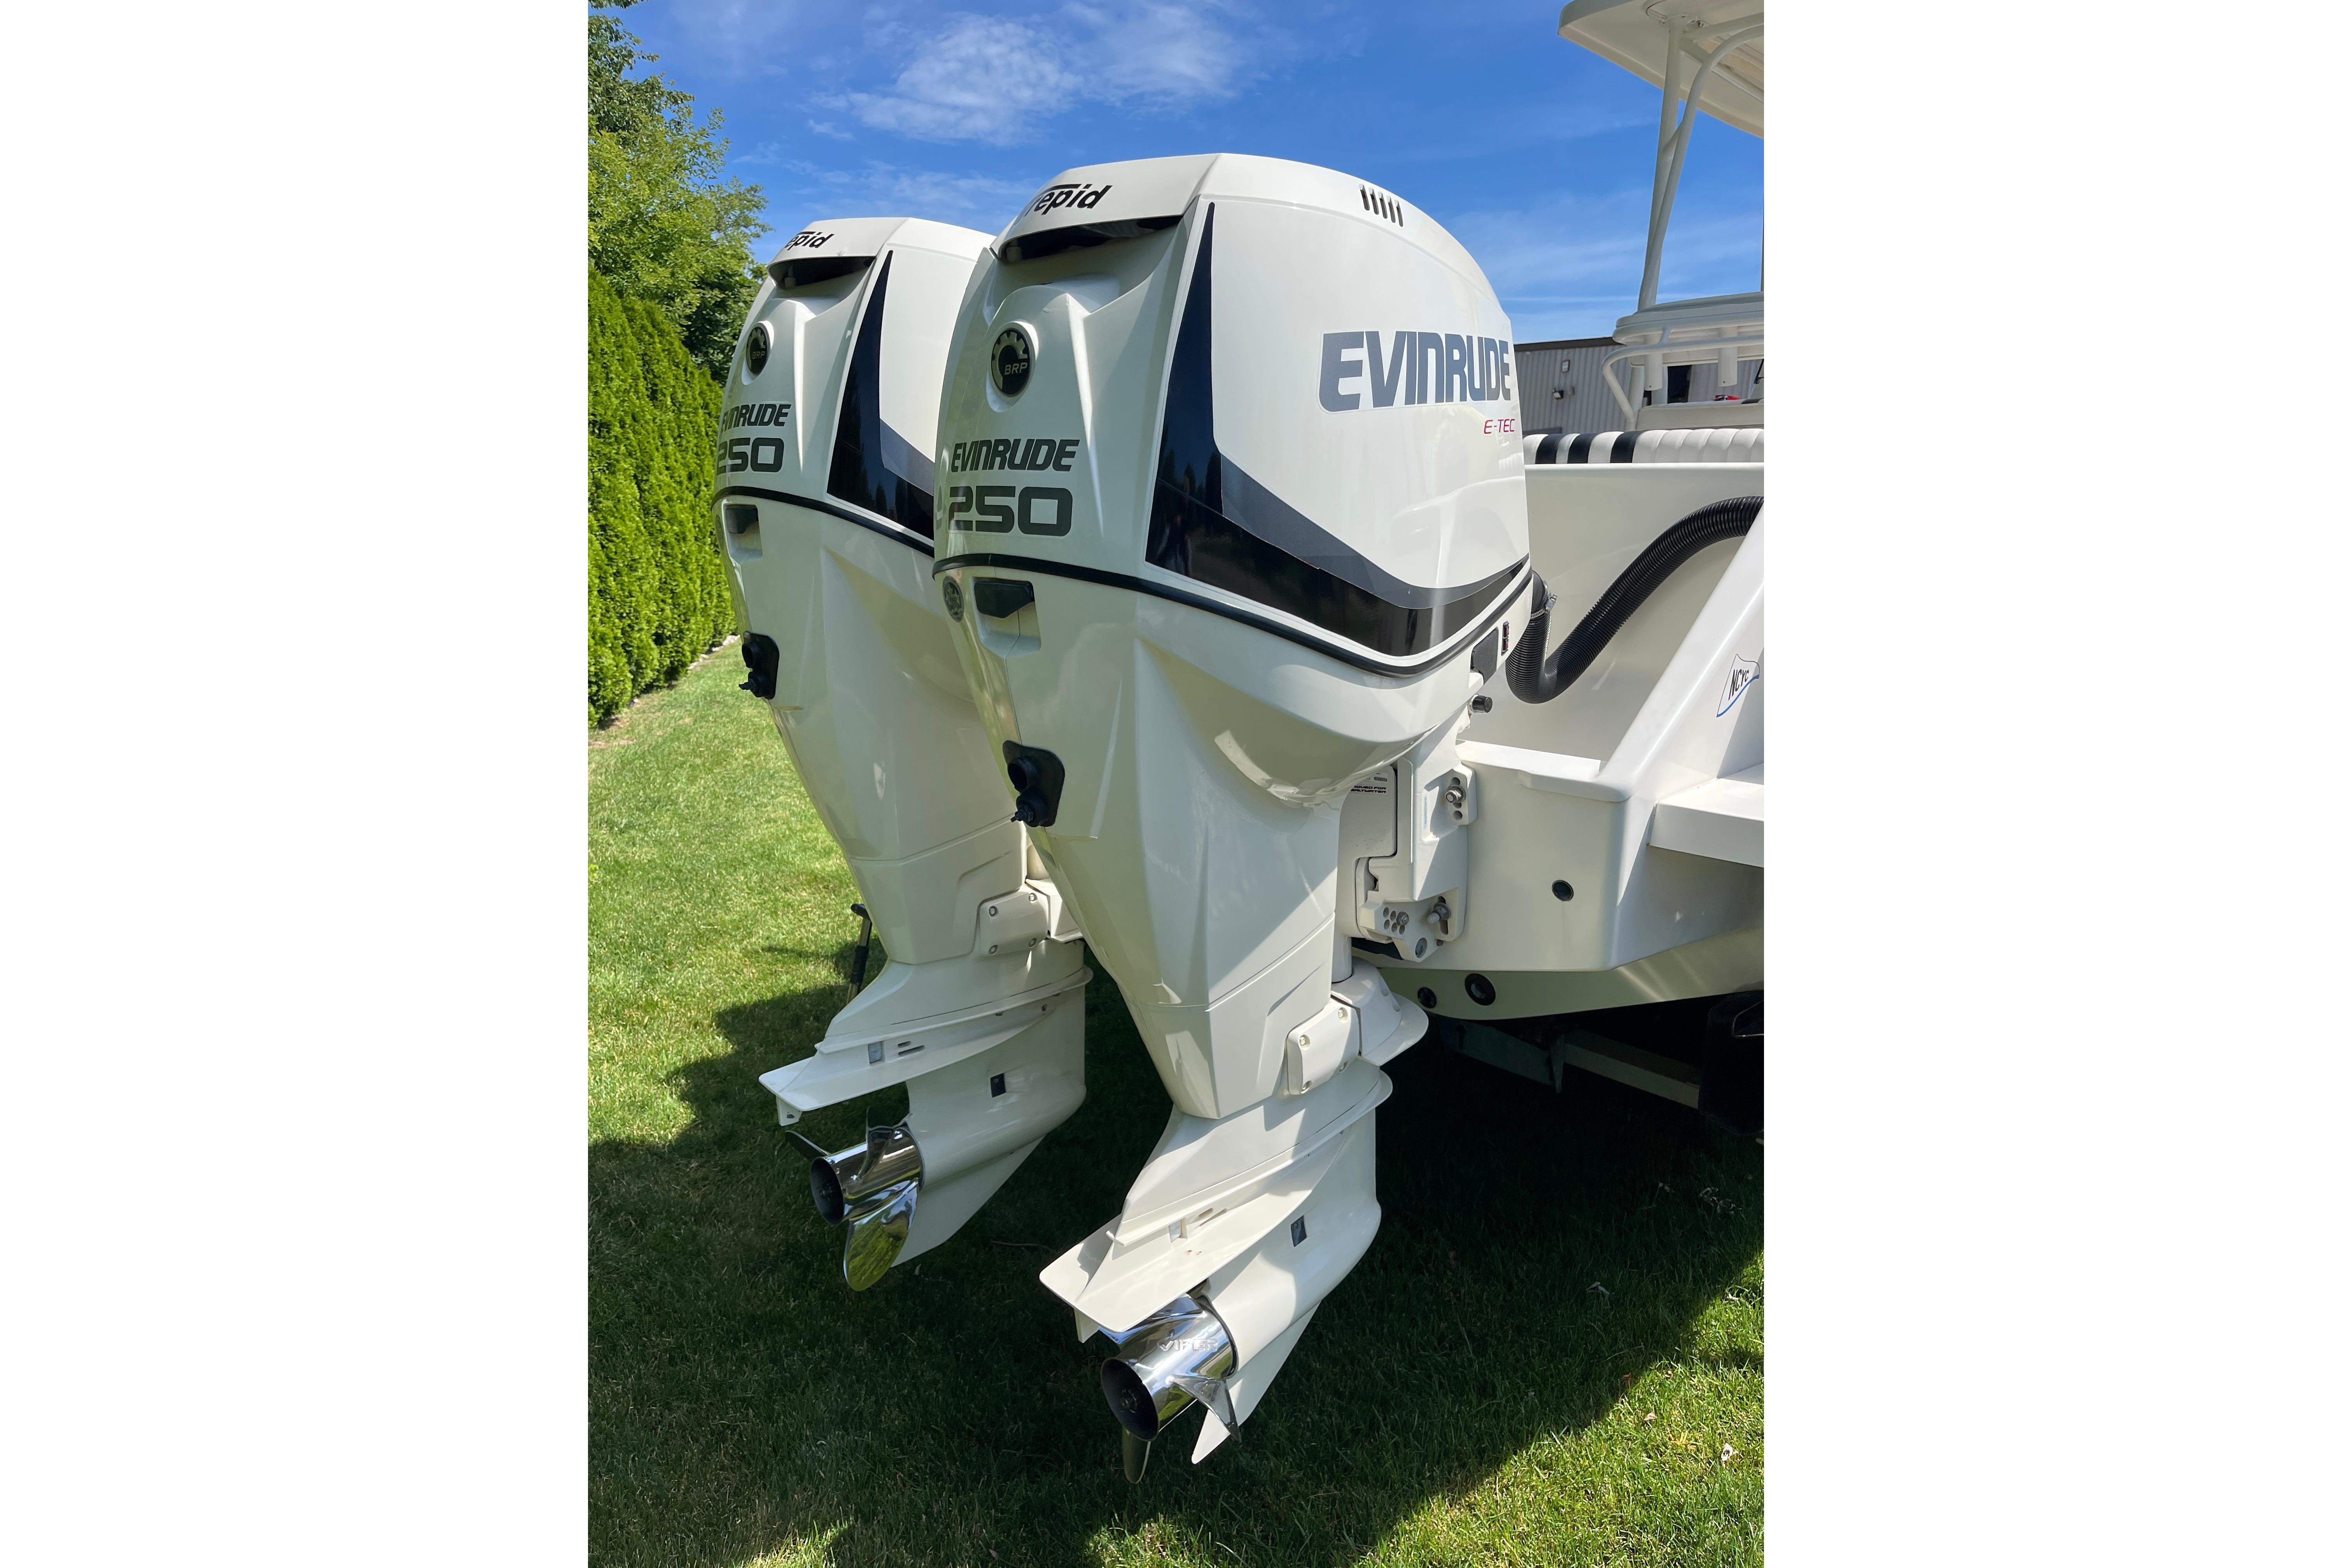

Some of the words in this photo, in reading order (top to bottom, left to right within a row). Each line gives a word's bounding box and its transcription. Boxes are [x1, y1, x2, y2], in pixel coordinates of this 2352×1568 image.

[752, 351, 765, 359] BRP
[1004, 362, 1028, 375] BRP
[1319, 331, 1511, 412] EVINRUDE
[721, 404, 791, 434] EVINRUDE
[1484, 419, 1515, 434] E-TEC
[716, 438, 784, 476] 250
[951, 438, 1080, 472] EVINRUDE
[948, 486, 1073, 537] 250
[1728, 668, 1749, 701] NCYC
[1157, 1339, 1218, 1352] VIPER
